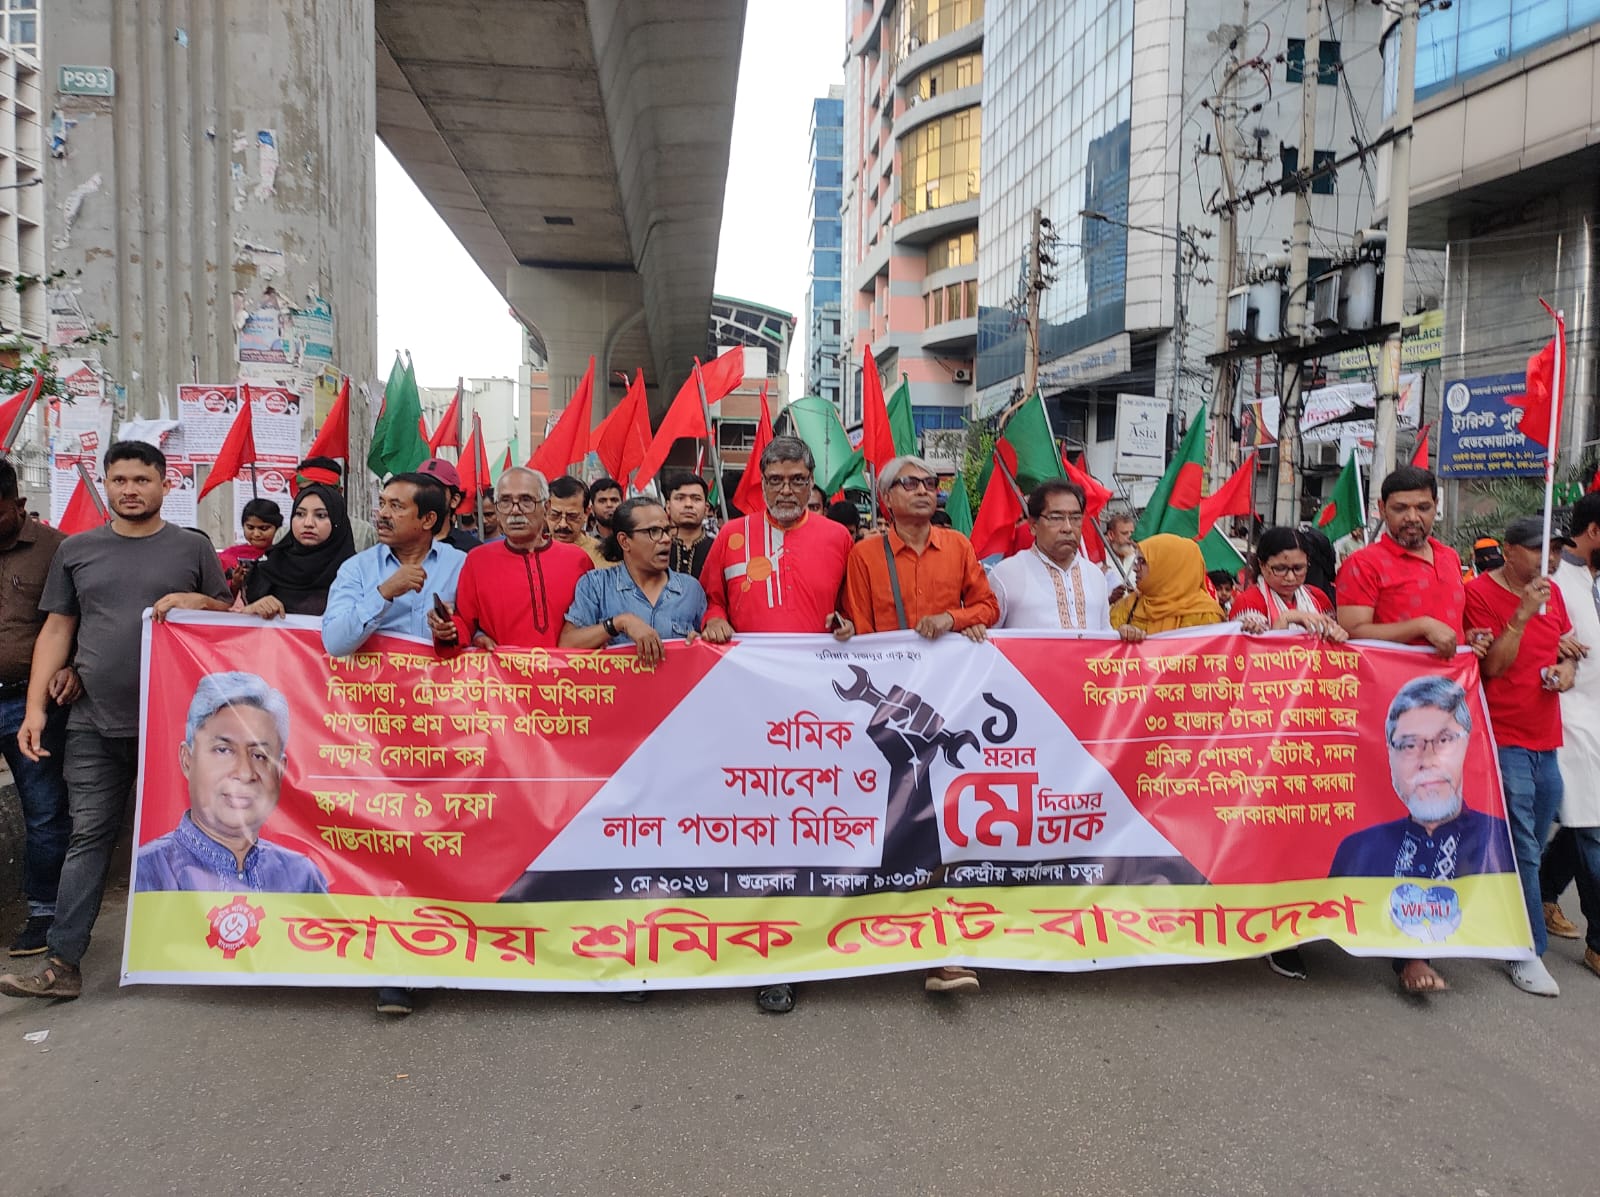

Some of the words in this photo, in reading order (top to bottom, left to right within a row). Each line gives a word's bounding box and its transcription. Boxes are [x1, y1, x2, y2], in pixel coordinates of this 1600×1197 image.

[63, 70, 108, 88] P593
[1085, 653, 1141, 678] বর্তমান
[1147, 652, 1198, 674] বাজার
[1203, 654, 1228, 673] দর
[1234, 655, 1245, 671] ও
[1249, 645, 1322, 674] মাথাপিছু
[1325, 650, 1361, 671] আয়
[413, 678, 532, 707] ট্রেডইউনিয়ন
[537, 678, 616, 705] অধিকার
[1082, 680, 1148, 706] বিবেচনা
[1153, 682, 1186, 702] করে
[1191, 676, 1245, 702] জাতীয়
[1316, 674, 1361, 702] মজুরি
[323, 706, 407, 735] গণতান্ত্রিক
[413, 713, 445, 736] শ্রম
[450, 709, 508, 736] আইন
[514, 708, 592, 736] প্রতিষ্ঠার
[766, 710, 855, 752] শ্রমিক
[981, 692, 1018, 744] ১
[1145, 714, 1167, 732] ৩০
[1173, 710, 1224, 733] হাজার
[1229, 706, 1274, 730] টাকা
[1281, 706, 1326, 728] ঘোষণা
[1328, 707, 1359, 728] কর
[318, 740, 374, 769] লড়াই
[381, 744, 448, 768] বেগবান
[455, 746, 488, 768] কর
[983, 747, 1036, 768] মহান
[1145, 742, 1192, 769] শ্রমিক
[1323, 744, 1357, 764] দমন
[721, 763, 843, 798] সমাবেশ
[853, 768, 877, 793] ও
[1281, 775, 1307, 794] বন্ধ
[311, 789, 358, 817] স্কপ
[366, 792, 407, 818] এর
[415, 791, 432, 818] ৯
[442, 791, 497, 820] দফা
[943, 772, 1039, 848] মে
[1037, 788, 1103, 811] দিবসের
[1214, 803, 1306, 827] কলকারখানা
[1308, 802, 1331, 826] চালু
[1332, 802, 1357, 821] কর
[316, 825, 414, 856] বাস্তবায়ন
[421, 830, 465, 857] কর
[602, 813, 667, 848] লাল
[677, 813, 780, 847] পতাকা
[788, 806, 879, 849] মিছিল
[1037, 812, 1107, 844] ডাক
[613, 876, 624, 894] ১
[631, 875, 652, 892] মে
[658, 875, 709, 894] ২০২৬
[737, 873, 796, 892] শুক্রবার
[821, 871, 869, 891] সকাল
[954, 862, 1007, 883] কেন্দ্রীয়
[1011, 862, 1065, 882] কার্যালয়
[1068, 863, 1104, 884] চত্বর
[280, 906, 551, 966] জাতীয়
[571, 908, 800, 968] শ্রমিক
